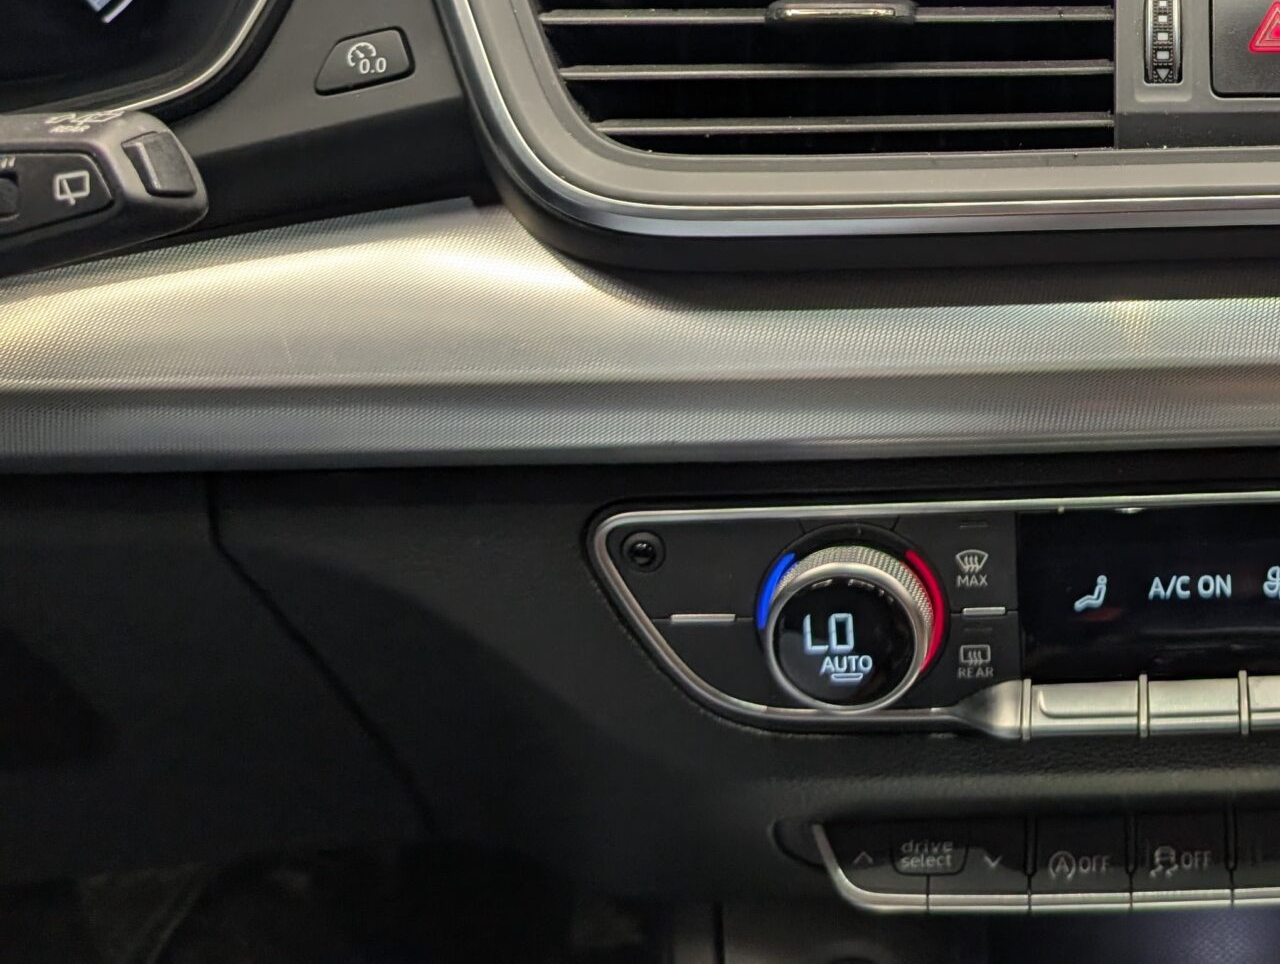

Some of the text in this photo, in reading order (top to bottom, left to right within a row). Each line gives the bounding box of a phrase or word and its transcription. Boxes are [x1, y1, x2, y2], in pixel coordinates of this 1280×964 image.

[358, 57, 388, 75] 0.0
[957, 573, 988, 587] MAX
[1148, 574, 1232, 600] A/C ON
[803, 613, 854, 655] LO
[820, 656, 873, 673] AUTO
[957, 667, 994, 680] REAR
[901, 838, 953, 854] drive
[900, 853, 953, 870] select
[1079, 855, 1113, 874] OFF
[1180, 851, 1213, 870] OFF
